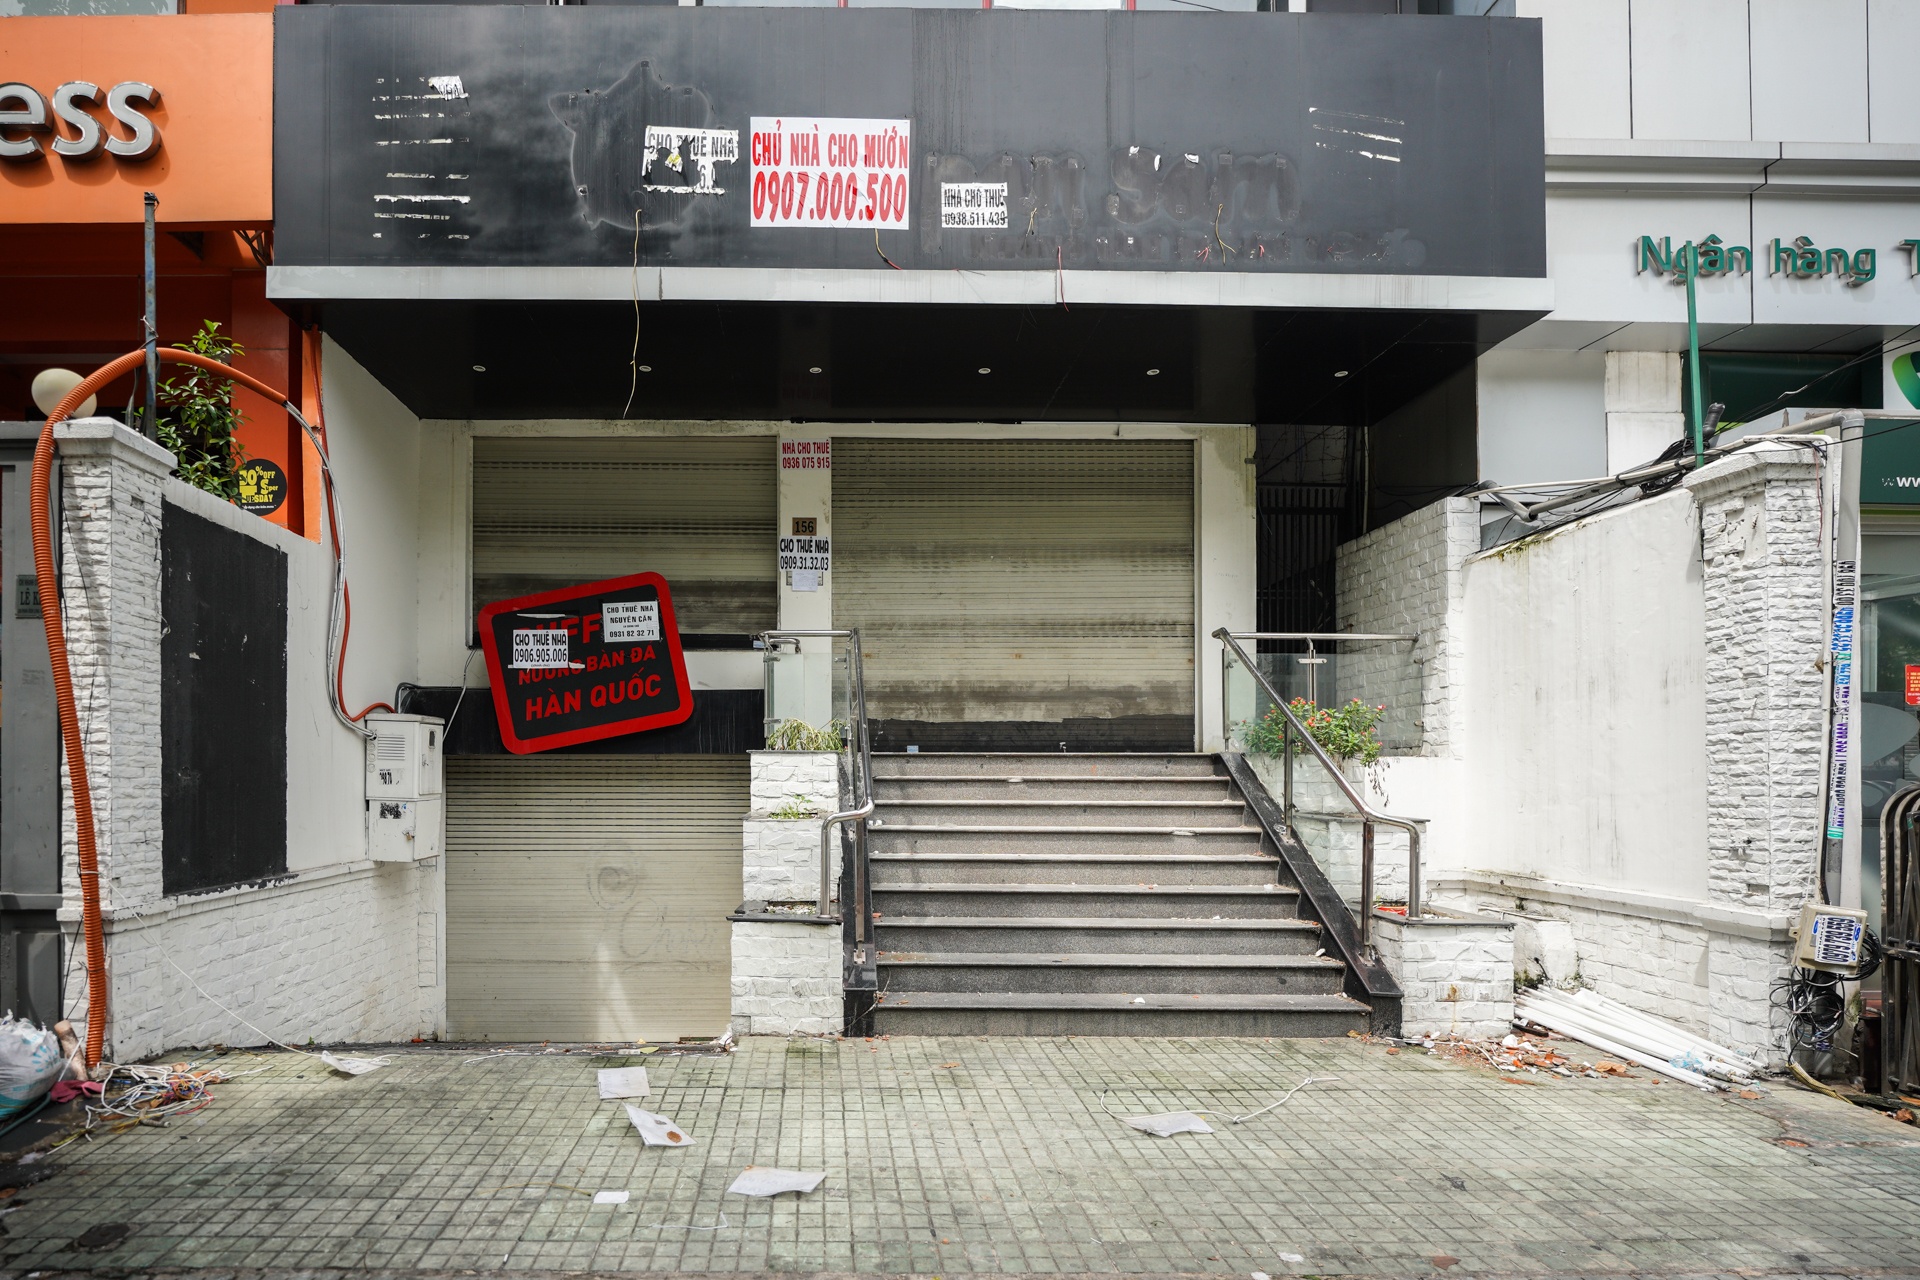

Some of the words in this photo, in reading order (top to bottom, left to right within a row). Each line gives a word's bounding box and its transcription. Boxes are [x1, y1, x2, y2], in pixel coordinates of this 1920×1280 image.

[0, 80, 160, 162] ess
[711, 131, 735, 158] NHÀ
[752, 118, 782, 167] CHỦ
[790, 123, 820, 167] NHÀ
[828, 132, 858, 168] CHO
[864, 126, 908, 169] MƯỚN
[753, 170, 907, 223] 0907.000.500
[944, 184, 962, 208] NHÀ
[944, 210, 1006, 226] 0938.511.439
[1637, 234, 1751, 286] Ngân
[1769, 236, 1877, 288] hàng
[782, 439, 796, 455] NHÀ
[797, 441, 811, 454] CHO
[813, 438, 830, 454] THUÊ
[782, 456, 800, 469] 0936
[801, 456, 815, 469] 075
[817, 456, 830, 469] 915
[263, 471, 276, 479] OFF
[795, 520, 814, 533] 156
[780, 538, 794, 553] CHO
[796, 536, 813, 553] THUÊ
[814, 537, 829, 554] NHÀ
[780, 555, 829, 571] 0909.31.32.03
[606, 606, 619, 614] CHO
[621, 605, 638, 613] THUÊ
[514, 633, 530, 646] CHO
[532, 630, 550, 646] THUÊ
[551, 630, 567, 646] NHÀ
[514, 648, 568, 663] 0906.905.006
[586, 650, 625, 673] BÀN
[630, 640, 656, 665] ĐÁ
[525, 687, 581, 721] HÀN
[590, 667, 662, 708] QUỐC
